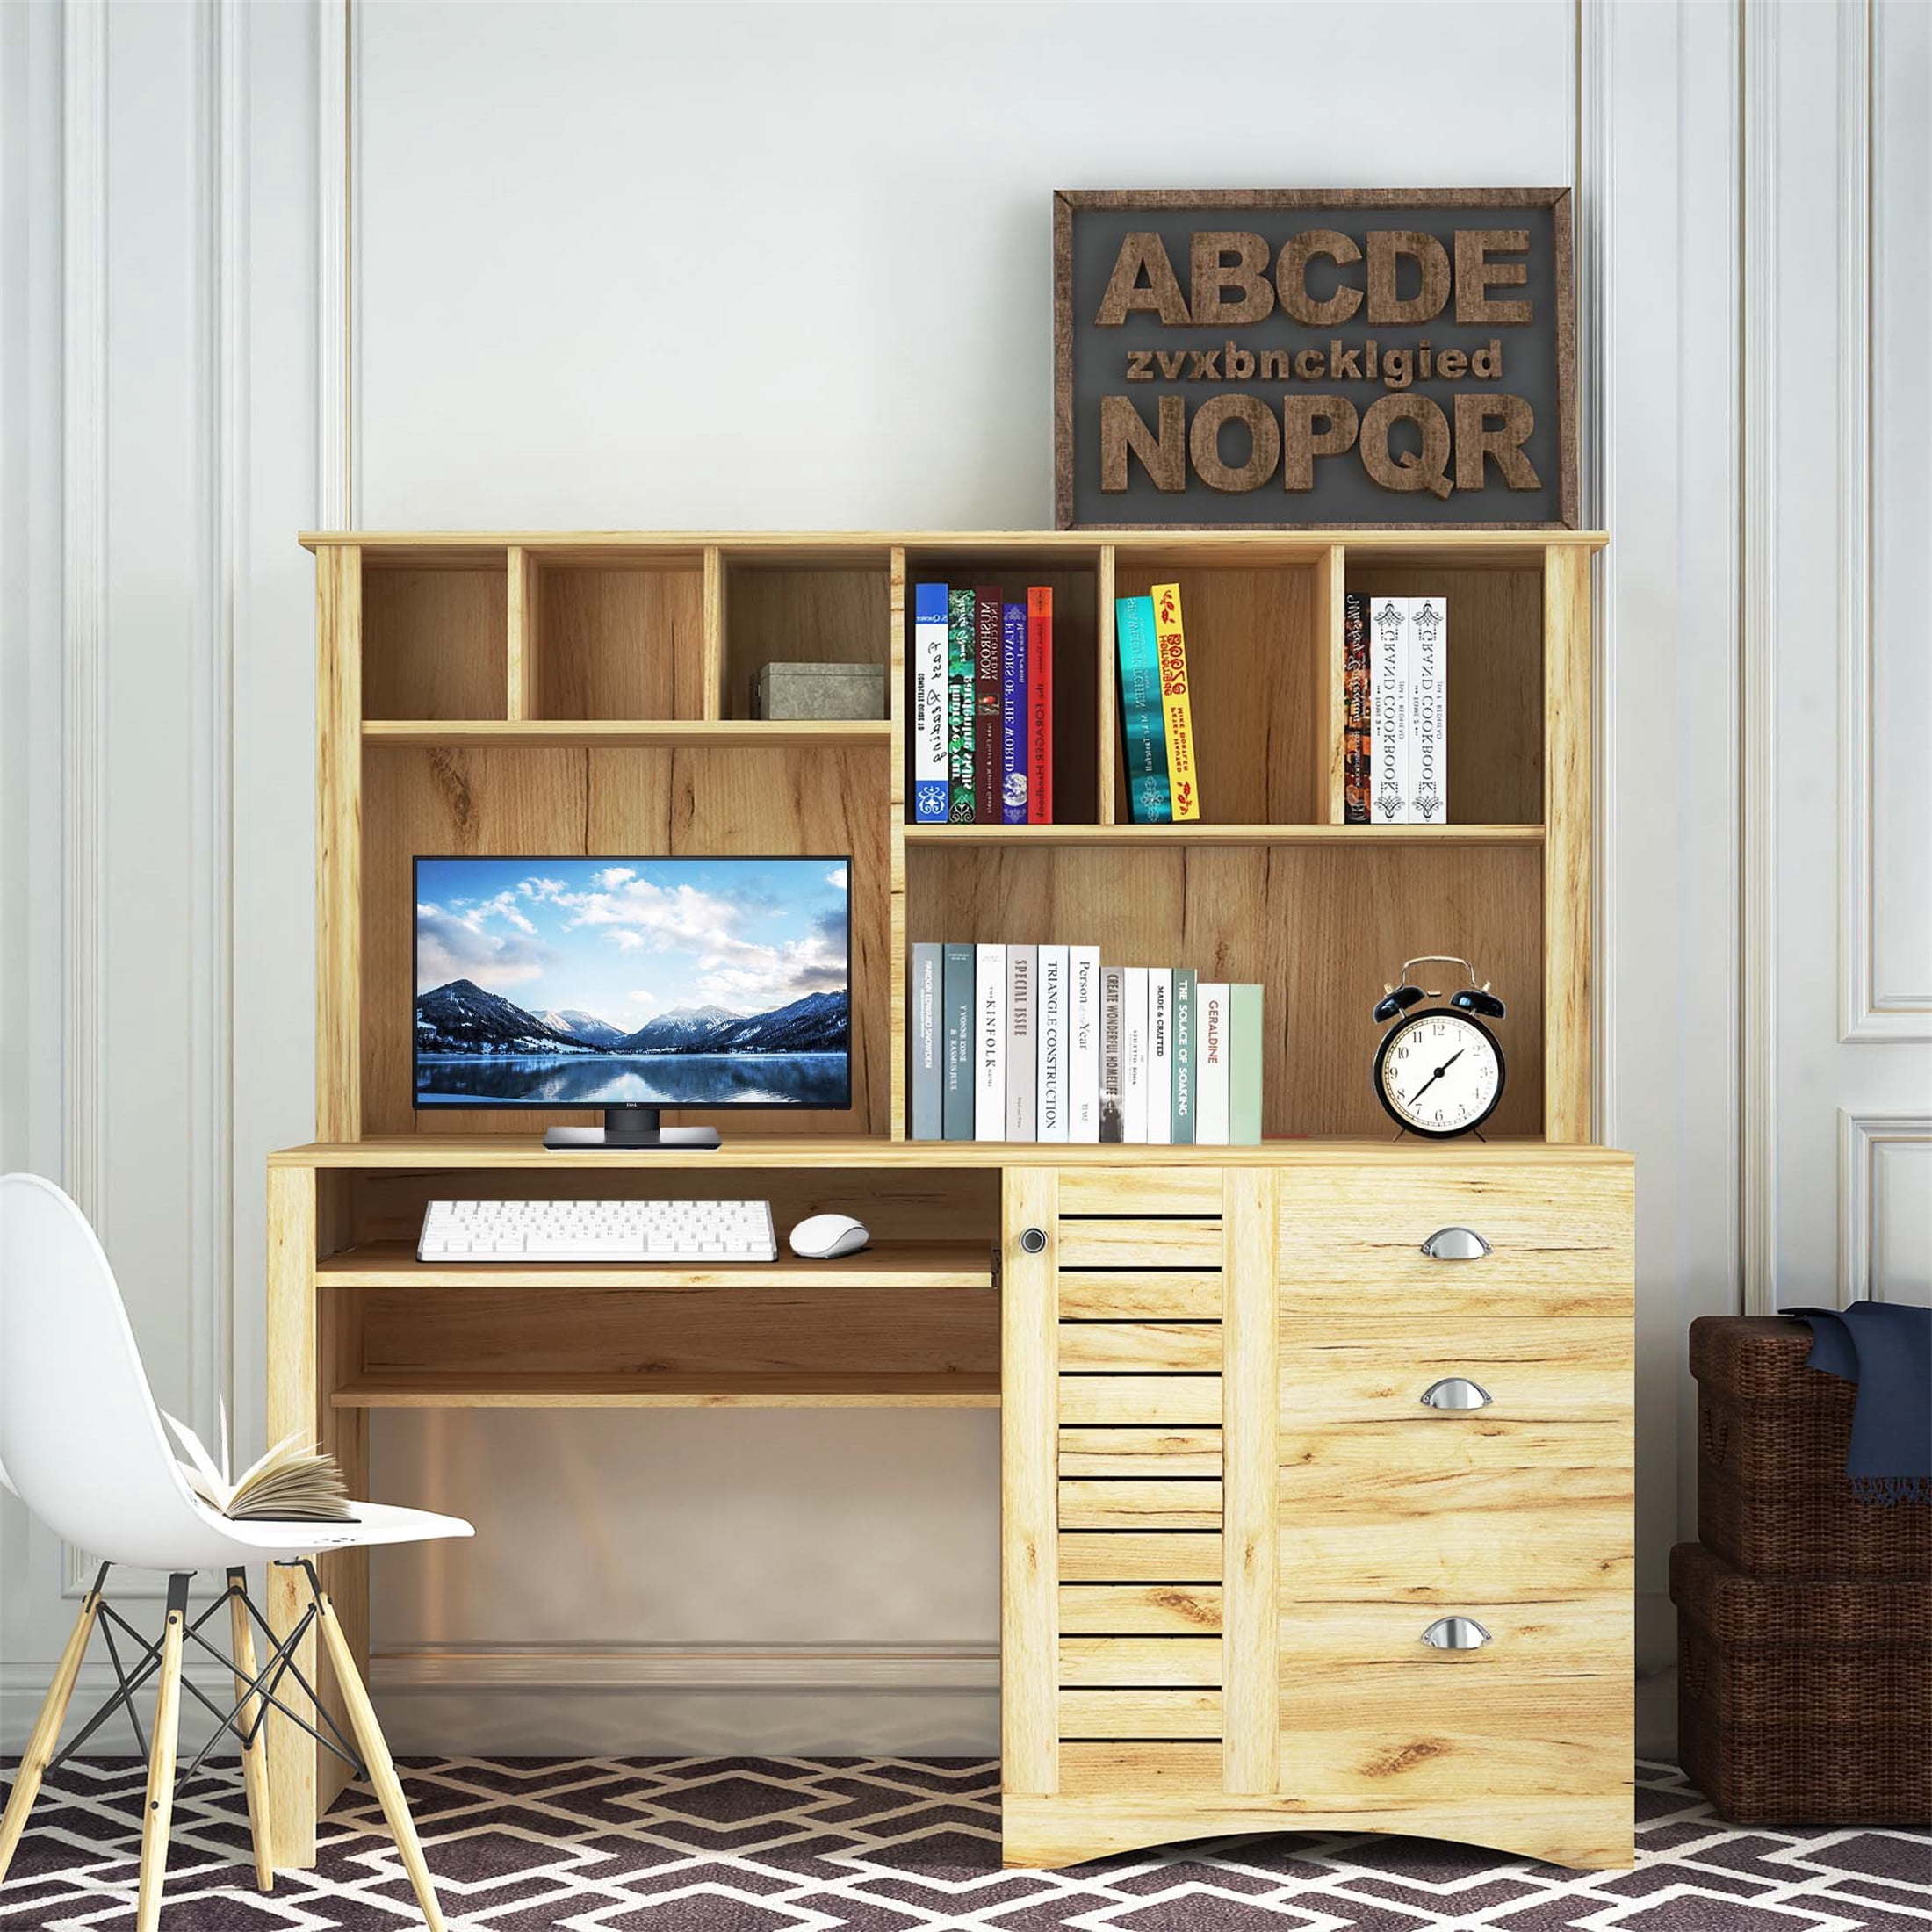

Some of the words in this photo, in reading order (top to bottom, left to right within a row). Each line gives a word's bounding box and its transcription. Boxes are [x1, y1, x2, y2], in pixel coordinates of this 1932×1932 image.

[1095, 229, 1533, 327] ABCDE
[1125, 339, 1503, 390] zvxbncklgied
[1100, 392, 1543, 502] NOPQR
[1014, 960, 1027, 1003] SPECIAL
[1047, 961, 1057, 1026] TRIANGLE
[1079, 962, 1090, 1003] Person
[1107, 974, 1119, 1003] CREATE
[1179, 980, 1187, 1000] THE
[985, 999, 996, 1068] KINFOLK
[1014, 1008, 1027, 1036] ISSUE
[1079, 1022, 1090, 1050] Year
[1107, 1006, 1118, 1054] WONDERFUL
[1179, 1006, 1187, 1045] SOLACE
[1208, 999, 1219, 1064] GERALDINE
[1432, 1024, 1445, 1036] 12
[1458, 1030, 1461, 1042] 1
[1413, 1031, 1423, 1043] 11
[1473, 1045, 1481, 1056] 2
[1179, 1049, 1187, 1063] OF
[1398, 1047, 1409, 1059] 10
[1046, 1028, 1057, 1128] CONSTRUCTION
[1106, 1056, 1118, 1095] HOMELIFE
[1390, 1067, 1398, 1079] 9
[1178, 1068, 1187, 1116] SOAKING
[1397, 1089, 1405, 1100] 8
[1415, 1103, 1423, 1115] 7
[1435, 1109, 1443, 1121] 6
[1458, 1104, 1466, 1116] 5
